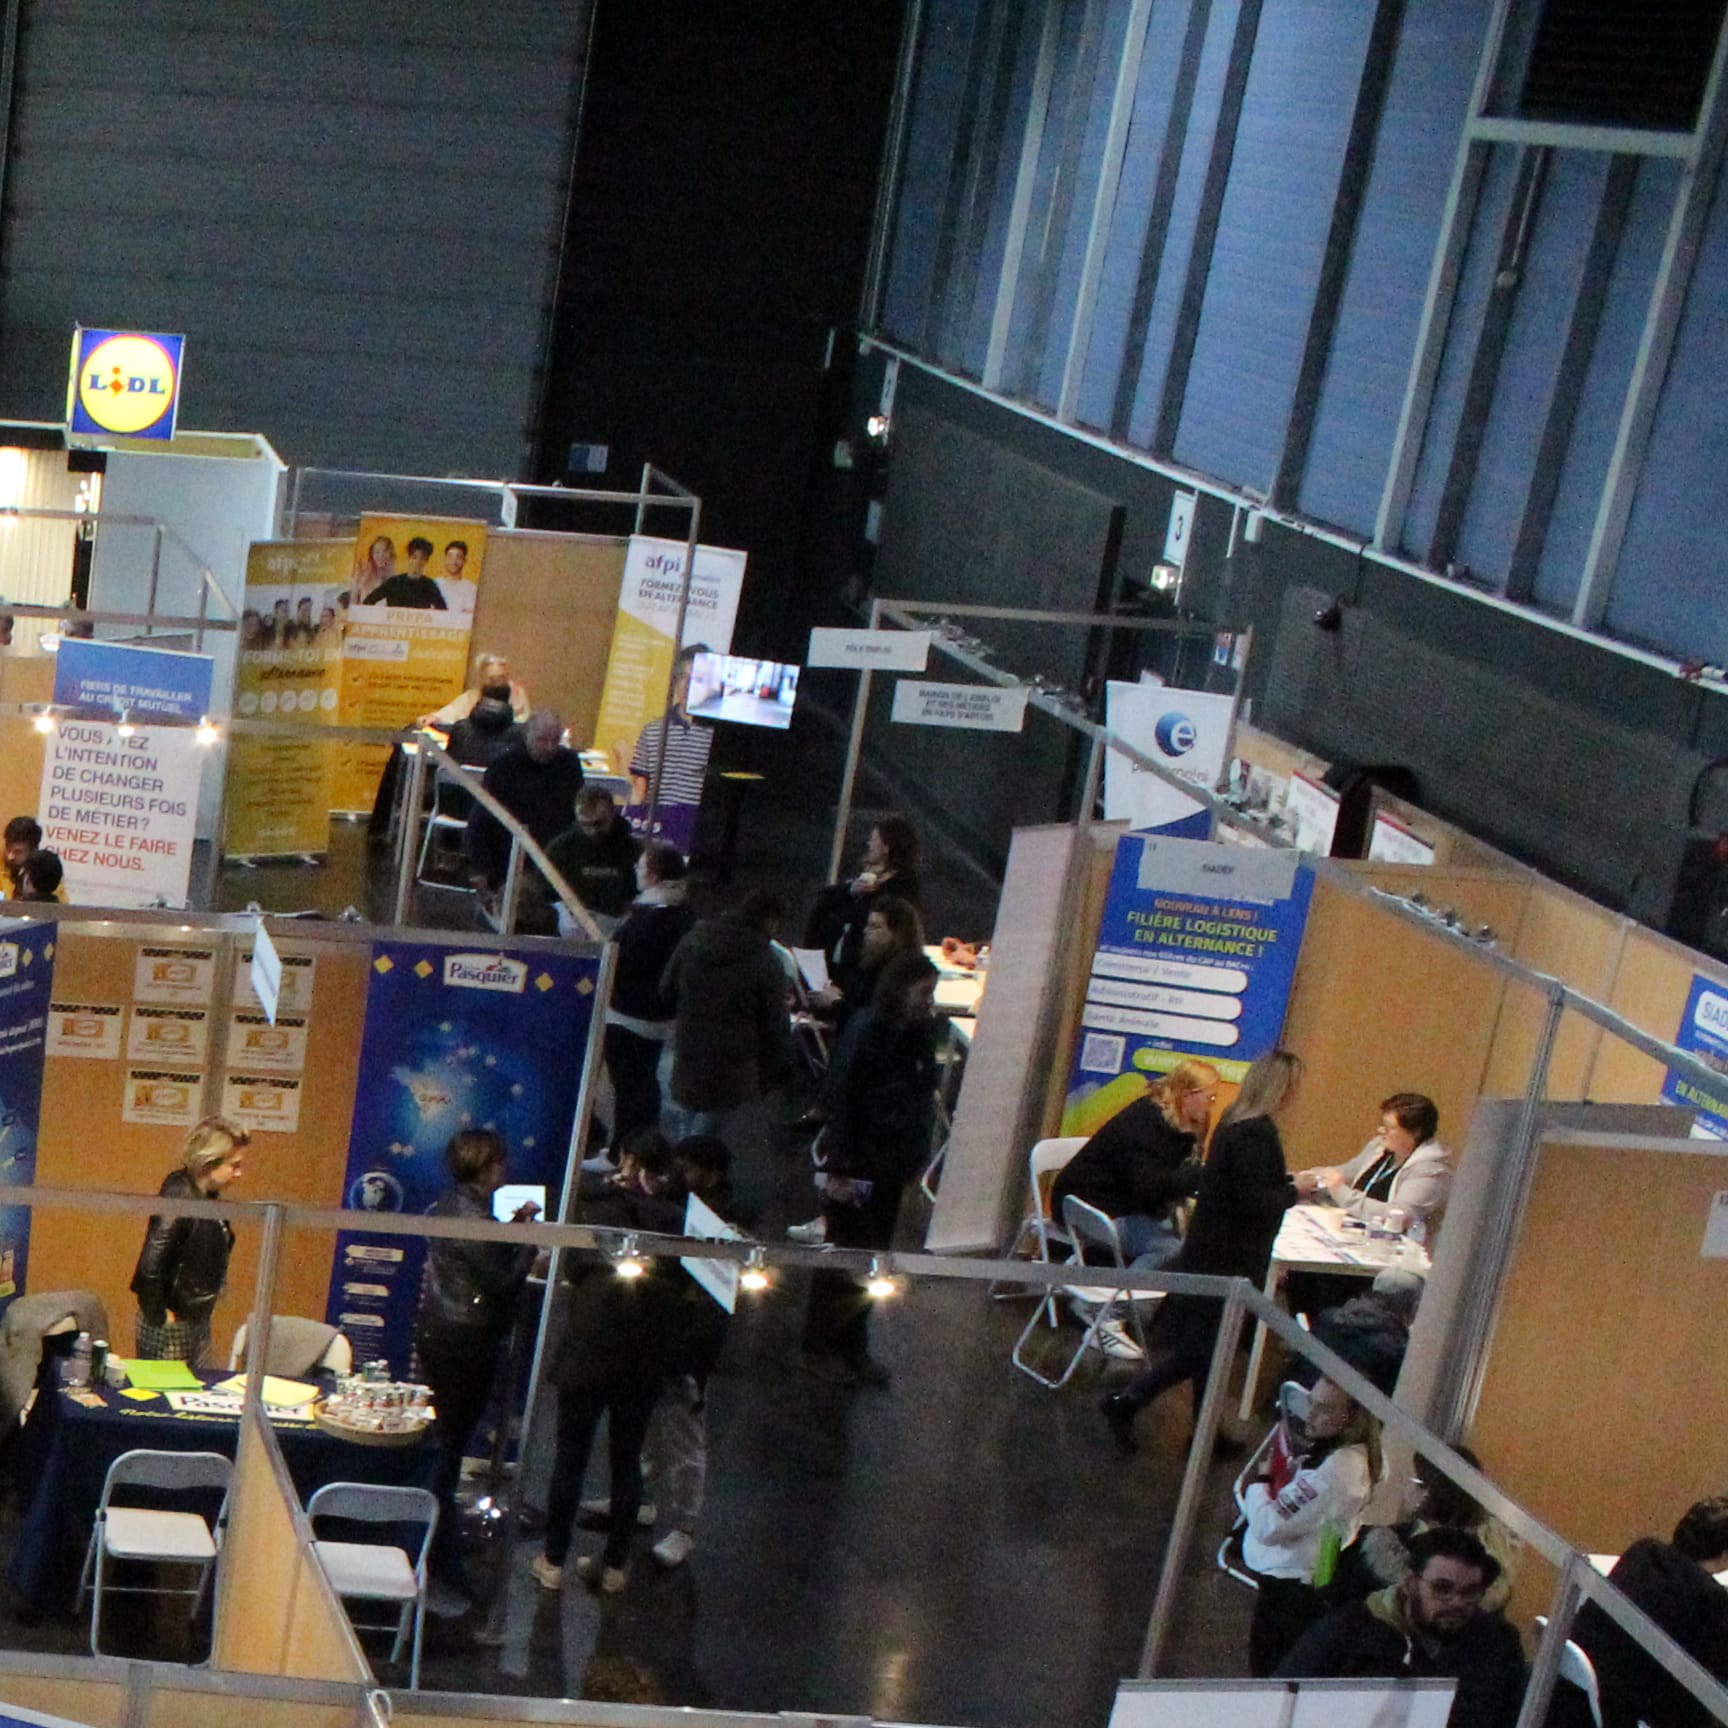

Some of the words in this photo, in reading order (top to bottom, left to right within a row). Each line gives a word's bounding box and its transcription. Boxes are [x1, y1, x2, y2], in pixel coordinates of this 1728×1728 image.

[645, 553, 681, 575] afpi
[57, 725, 104, 745] VOUS
[55, 747, 158, 772] L'INTENTION
[52, 765, 76, 781] DE
[79, 767, 165, 793] CHANGER
[47, 804, 71, 821] DE
[50, 784, 145, 811] PLUSIEURS
[147, 799, 187, 817] FOIS
[45, 825, 102, 846] VENEZ
[104, 833, 126, 849] LE
[129, 837, 178, 856] FAIRE
[92, 849, 146, 872] NOUS.
[1126, 910, 1182, 931] FILIÈRE
[1184, 918, 1279, 944] LOGISTIQUE
[1133, 928, 1155, 944] EN
[1158, 933, 1255, 959] ALTERNANCE
[449, 962, 520, 986] Pasquier
